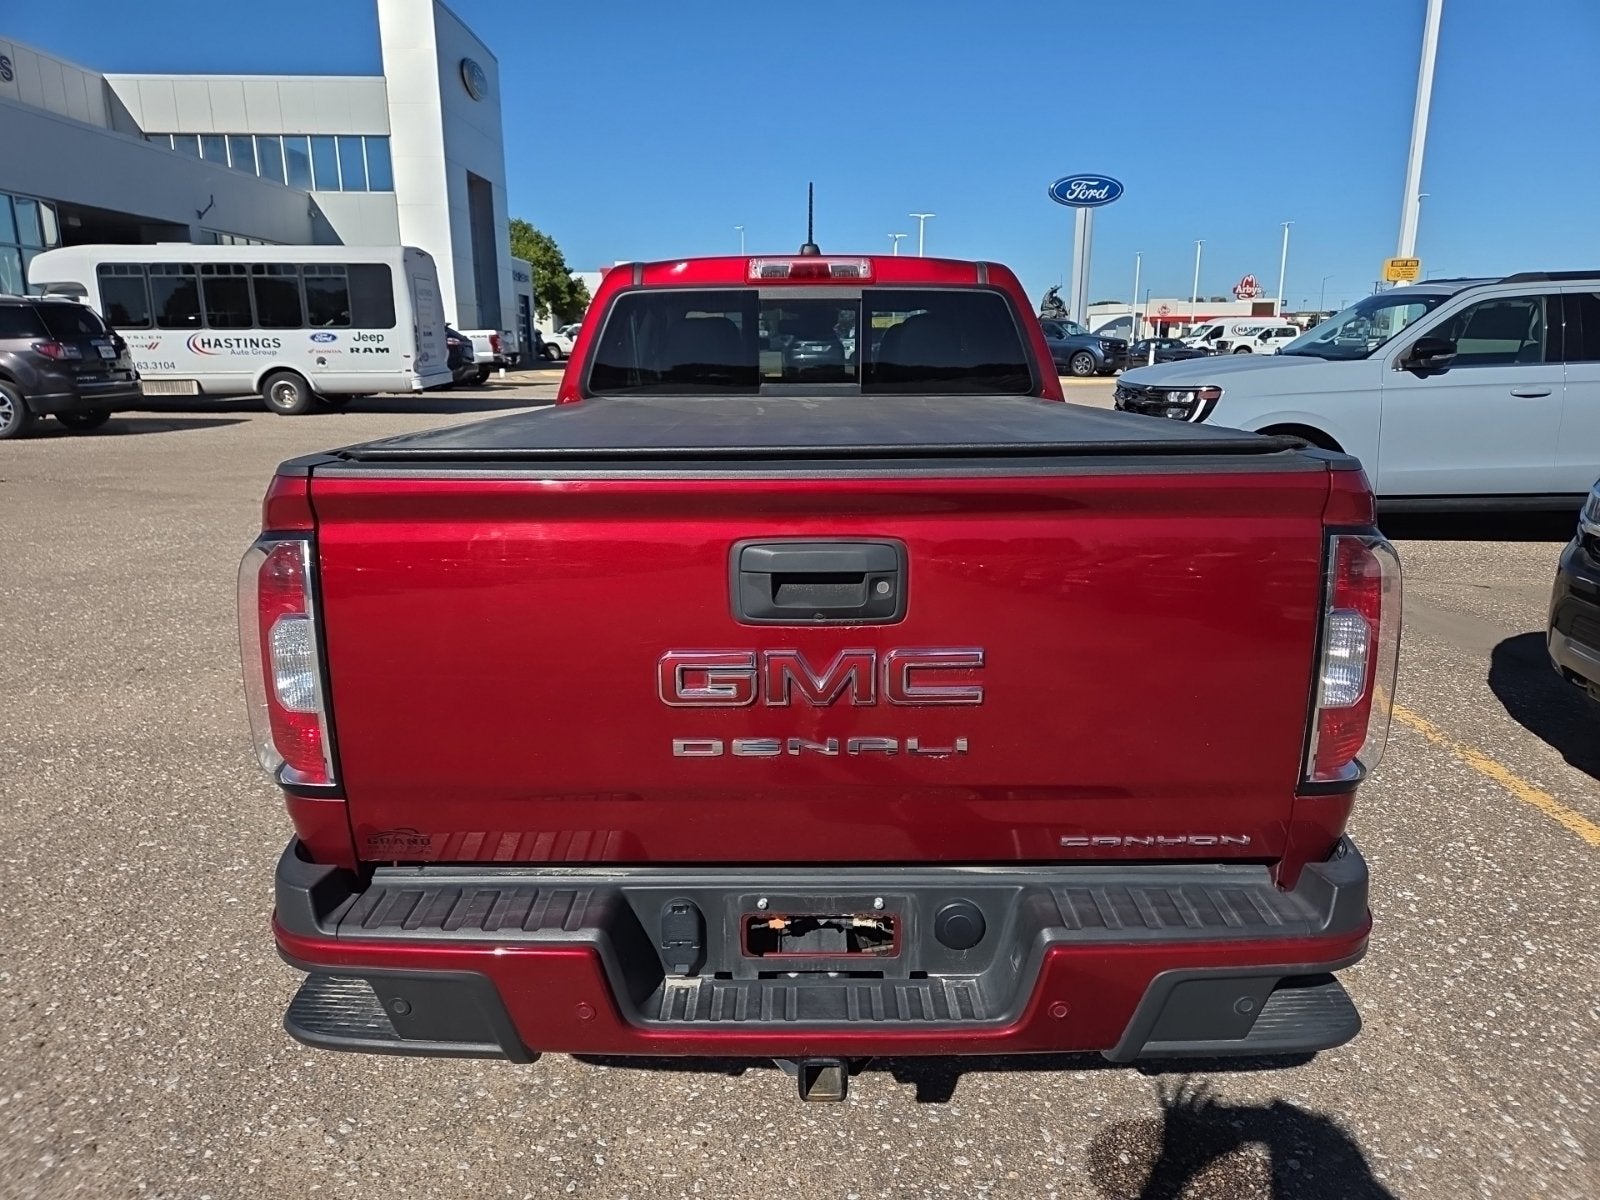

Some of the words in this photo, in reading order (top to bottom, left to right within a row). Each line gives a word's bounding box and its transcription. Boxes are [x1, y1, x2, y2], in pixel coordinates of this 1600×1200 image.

[1067, 180, 1110, 200] Ford
[1235, 284, 1262, 295] Arby's
[201, 337, 281, 349] HASTINGS
[312, 333, 334, 342] Ford
[353, 331, 385, 344] Jeep
[251, 348, 278, 357] Group
[656, 648, 985, 707] GMC
[672, 737, 969, 757] DENALI
[1060, 834, 1251, 846] CANYON
